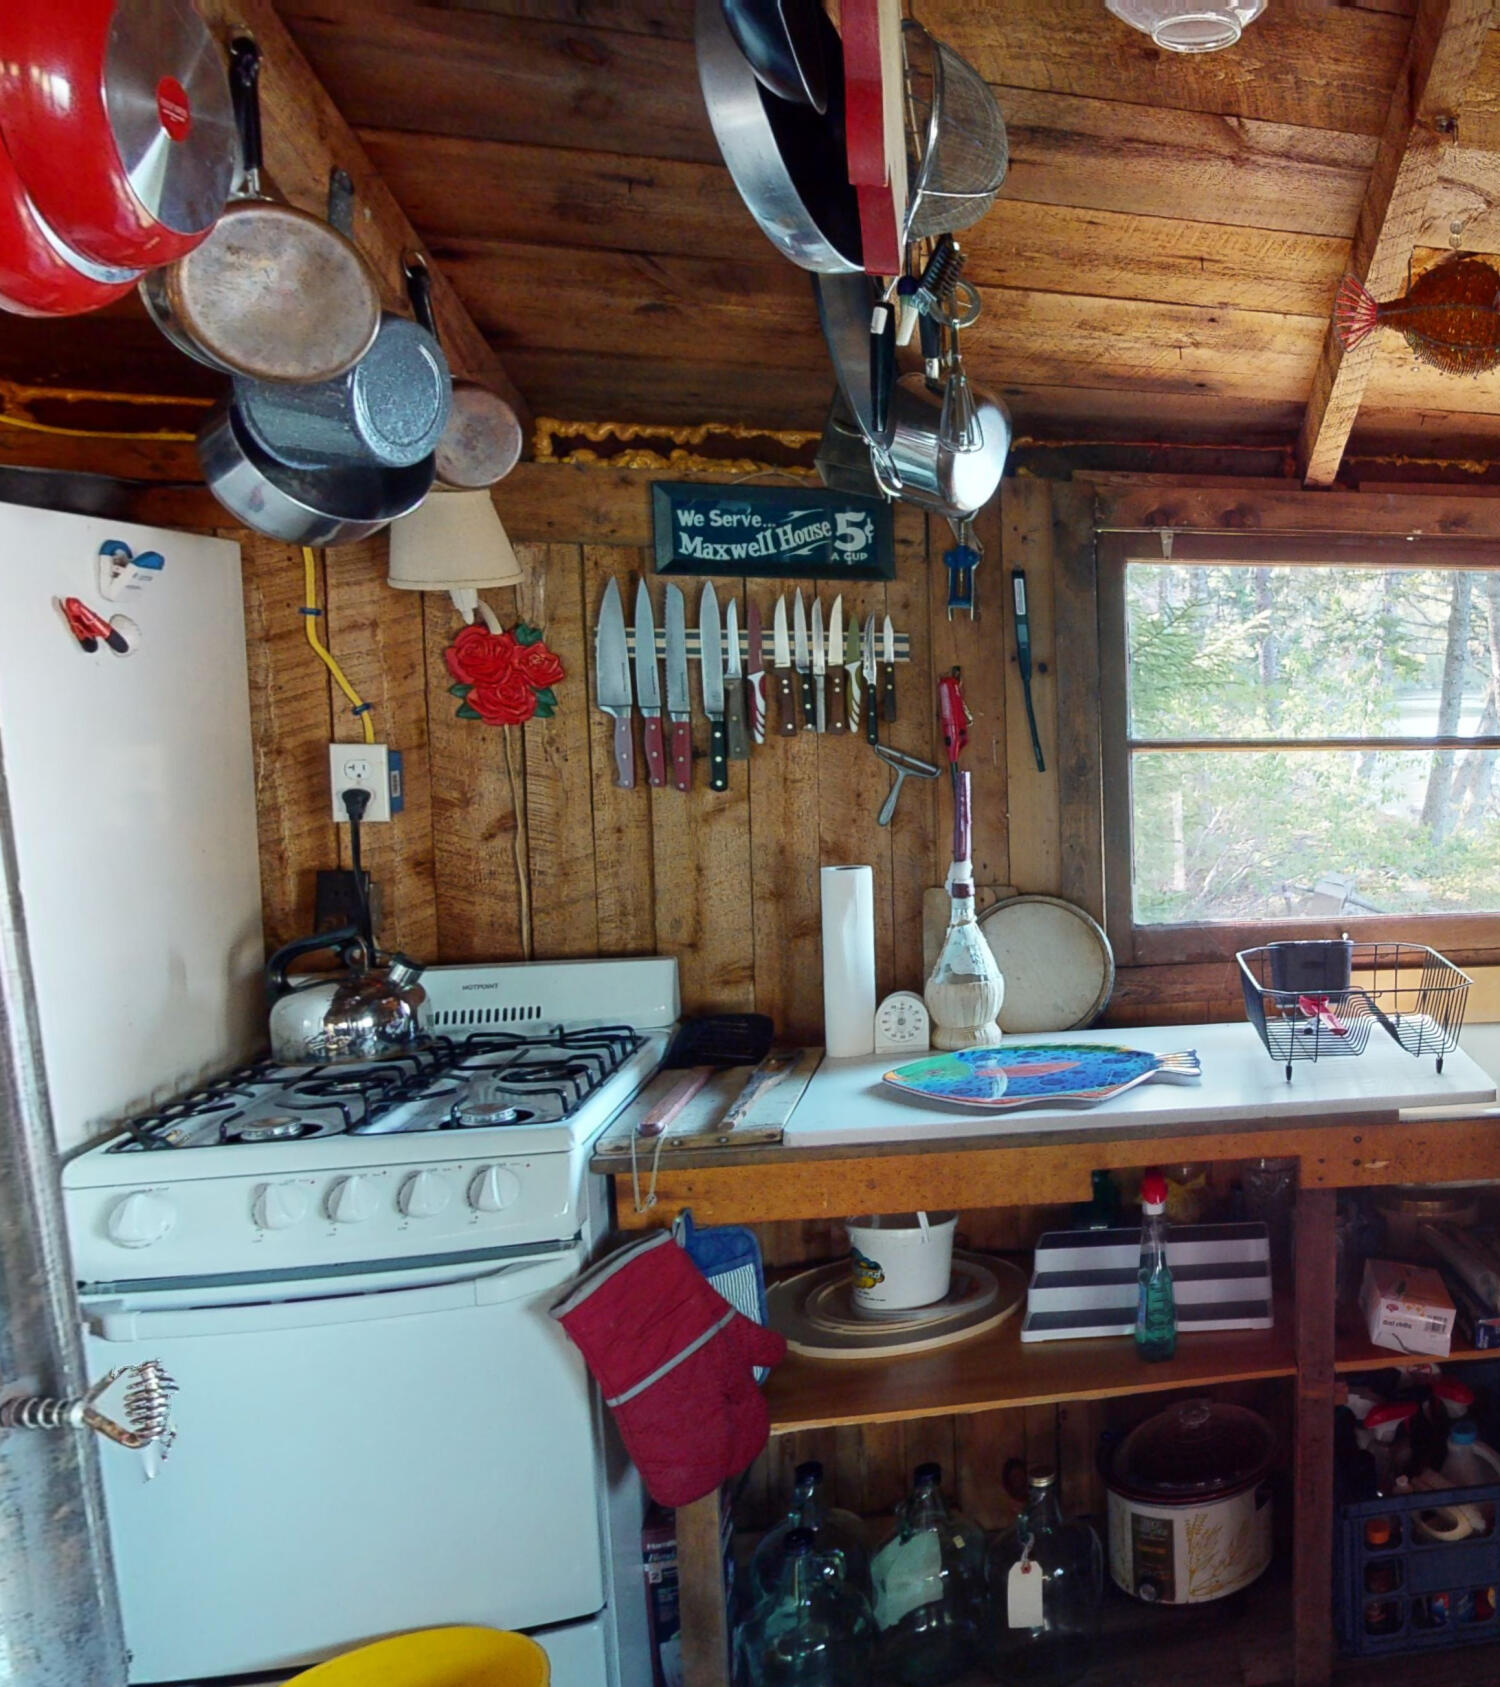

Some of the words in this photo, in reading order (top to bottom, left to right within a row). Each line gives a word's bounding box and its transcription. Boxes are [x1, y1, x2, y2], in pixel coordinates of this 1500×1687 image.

[677, 510, 704, 527] We
[678, 531, 776, 561] Maxwell
[775, 520, 832, 551] House
[831, 552, 840, 561] A
[843, 552, 868, 562] CUP
